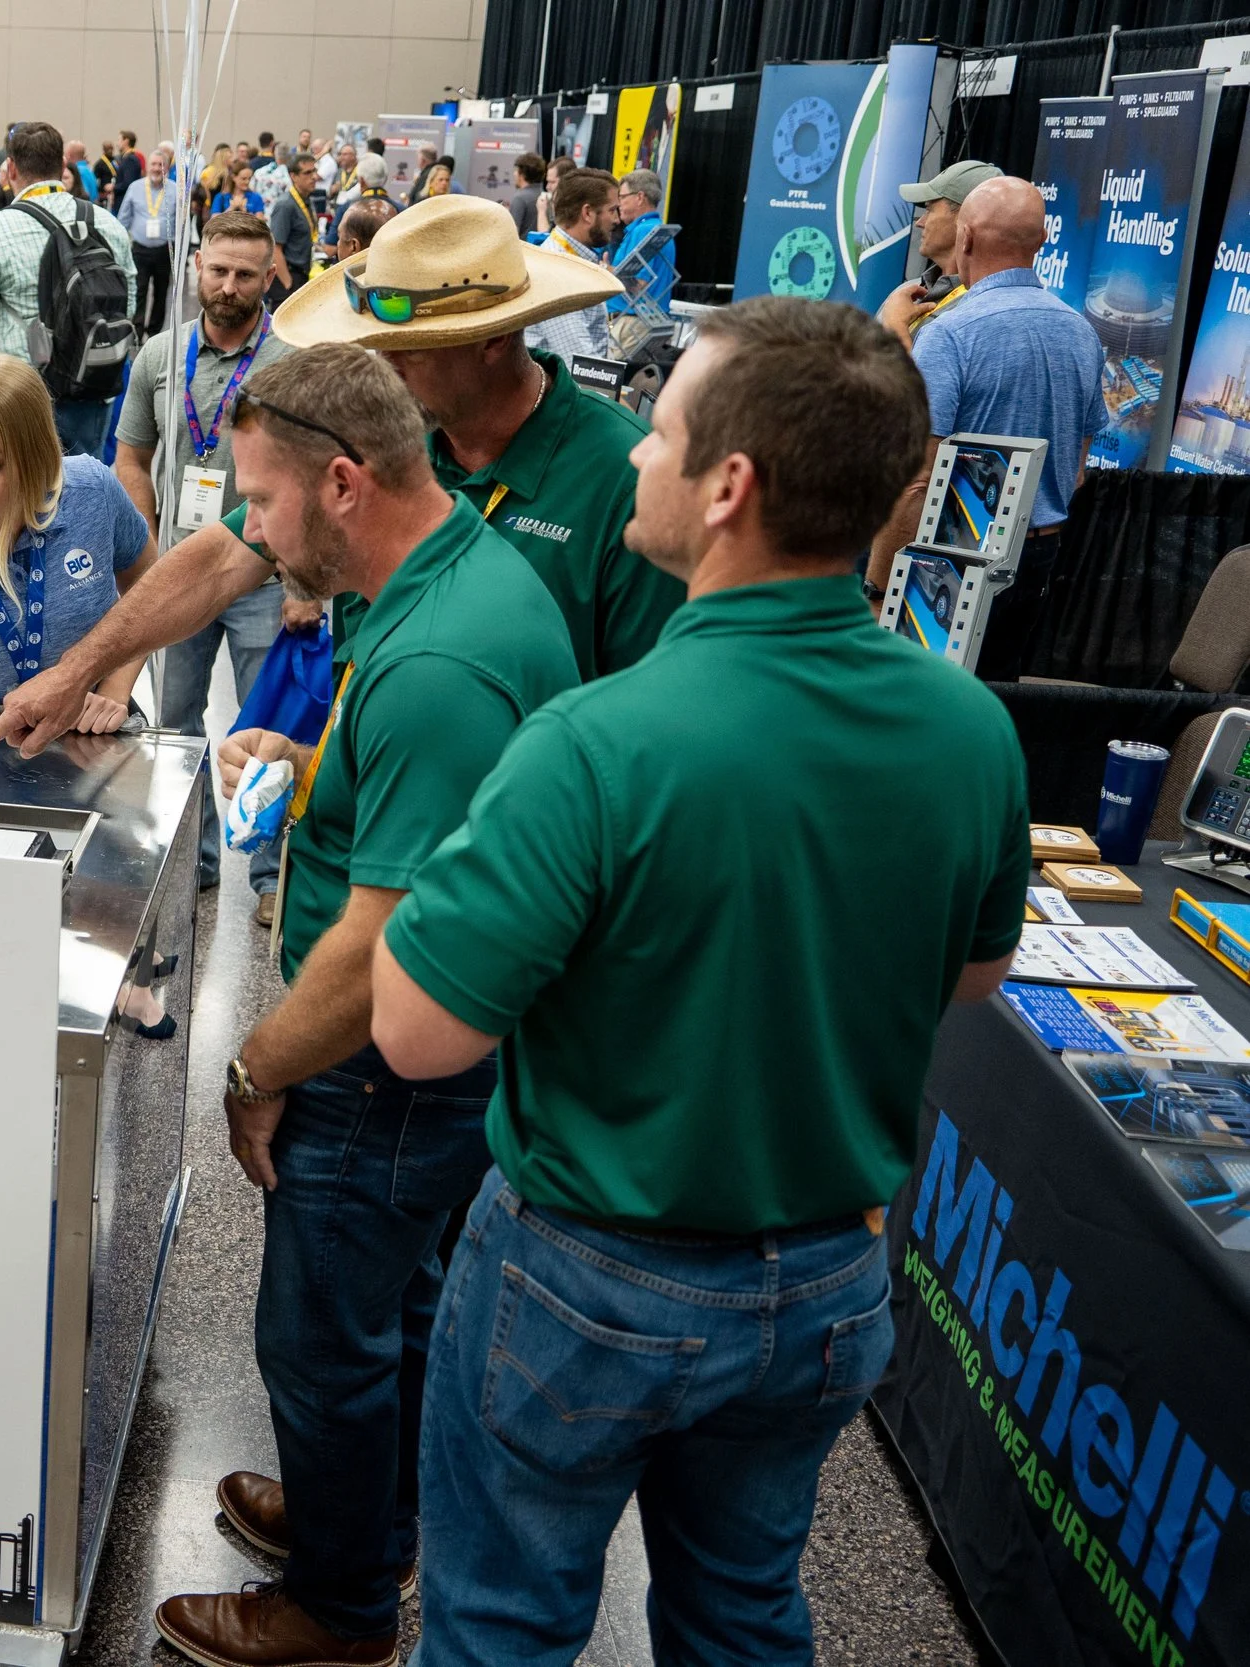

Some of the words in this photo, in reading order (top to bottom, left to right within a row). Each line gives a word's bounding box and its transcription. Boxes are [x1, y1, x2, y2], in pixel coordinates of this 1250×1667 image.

[1119, 94, 1138, 105] PUMPS
[1143, 92, 1159, 103] TANKS
[1165, 90, 1194, 102] FILTRATION
[1045, 116, 1061, 126] PUMPS
[1063, 116, 1078, 126] TANKS
[1082, 115, 1106, 126] FILTRATION
[1126, 107, 1139, 118] PIPE
[1143, 105, 1179, 118] SPILLGUARDS
[1050, 129, 1061, 138] PIPE
[1064, 129, 1094, 139] SPILLGUARDS
[788, 189, 809, 199] PTFE
[1100, 168, 1146, 209] Liquid
[1106, 210, 1179, 256] Handling
[572, 363, 618, 385] Brandenburg
[1085, 454, 1100, 468] can
[1169, 444, 1195, 466] Effluent
[1194, 451, 1214, 468] Water
[517, 516, 572, 537] SEPRATECH
[532, 529, 567, 543] SOLUTIONS
[66, 554, 92, 576] BIC
[69, 570, 104, 591] ALLIANCE
[1106, 791, 1132, 804] Michelli
[903, 1241, 983, 1391] WEIGHING
[979, 1376, 998, 1414] &
[911, 1108, 1235, 1643] Michelli
